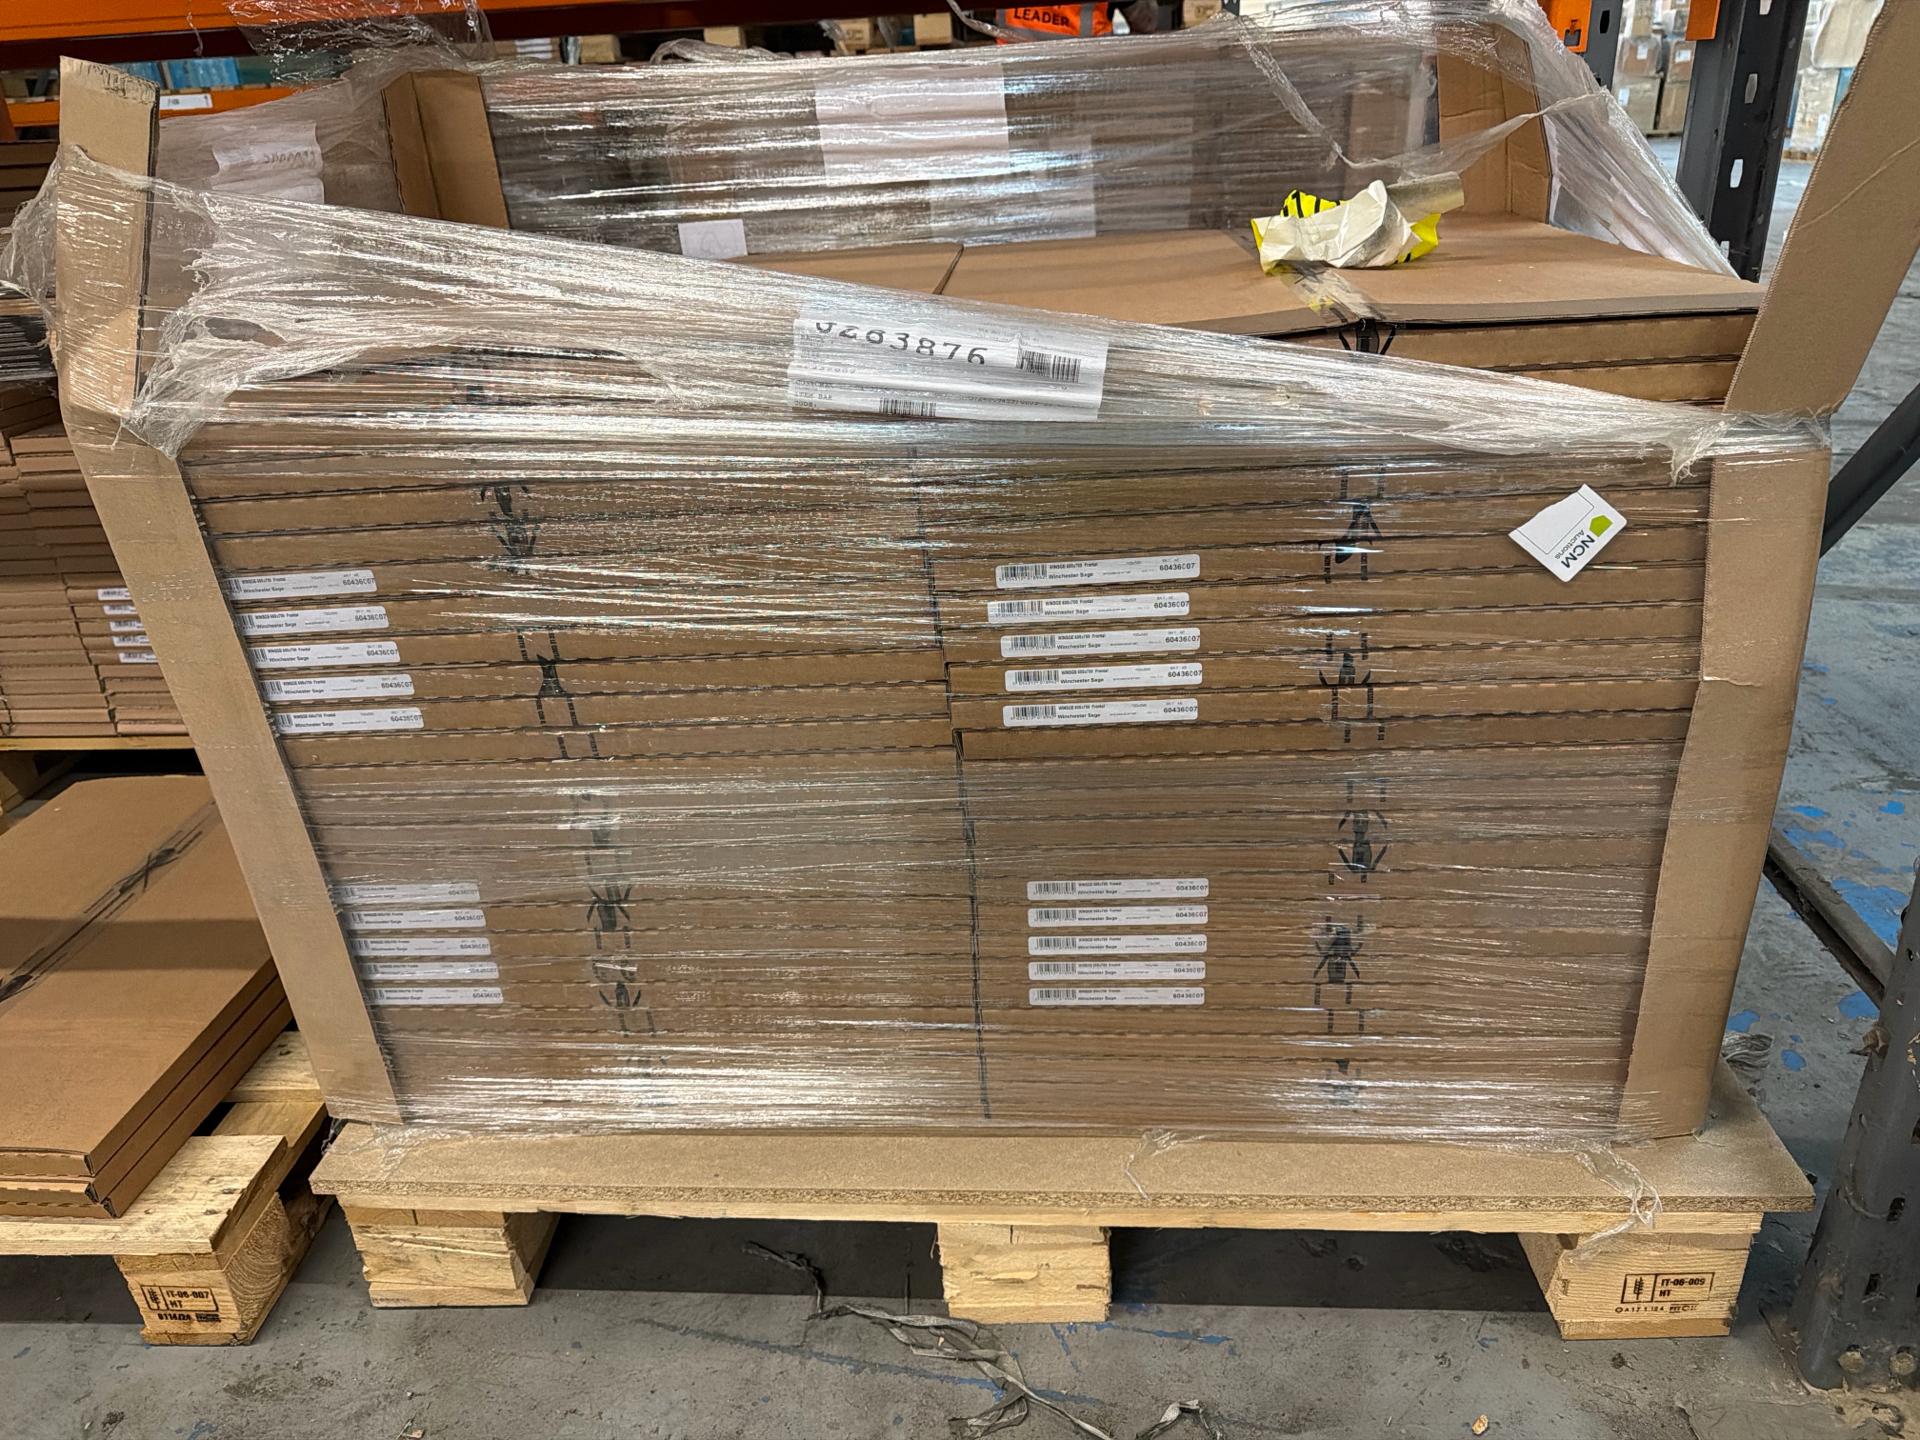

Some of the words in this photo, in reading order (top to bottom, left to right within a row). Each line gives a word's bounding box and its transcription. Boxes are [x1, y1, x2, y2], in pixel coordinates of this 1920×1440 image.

[1013, 8, 1071, 27] LEADER
[1554, 529, 1585, 559] Auctions
[1560, 534, 1596, 569] NCM
